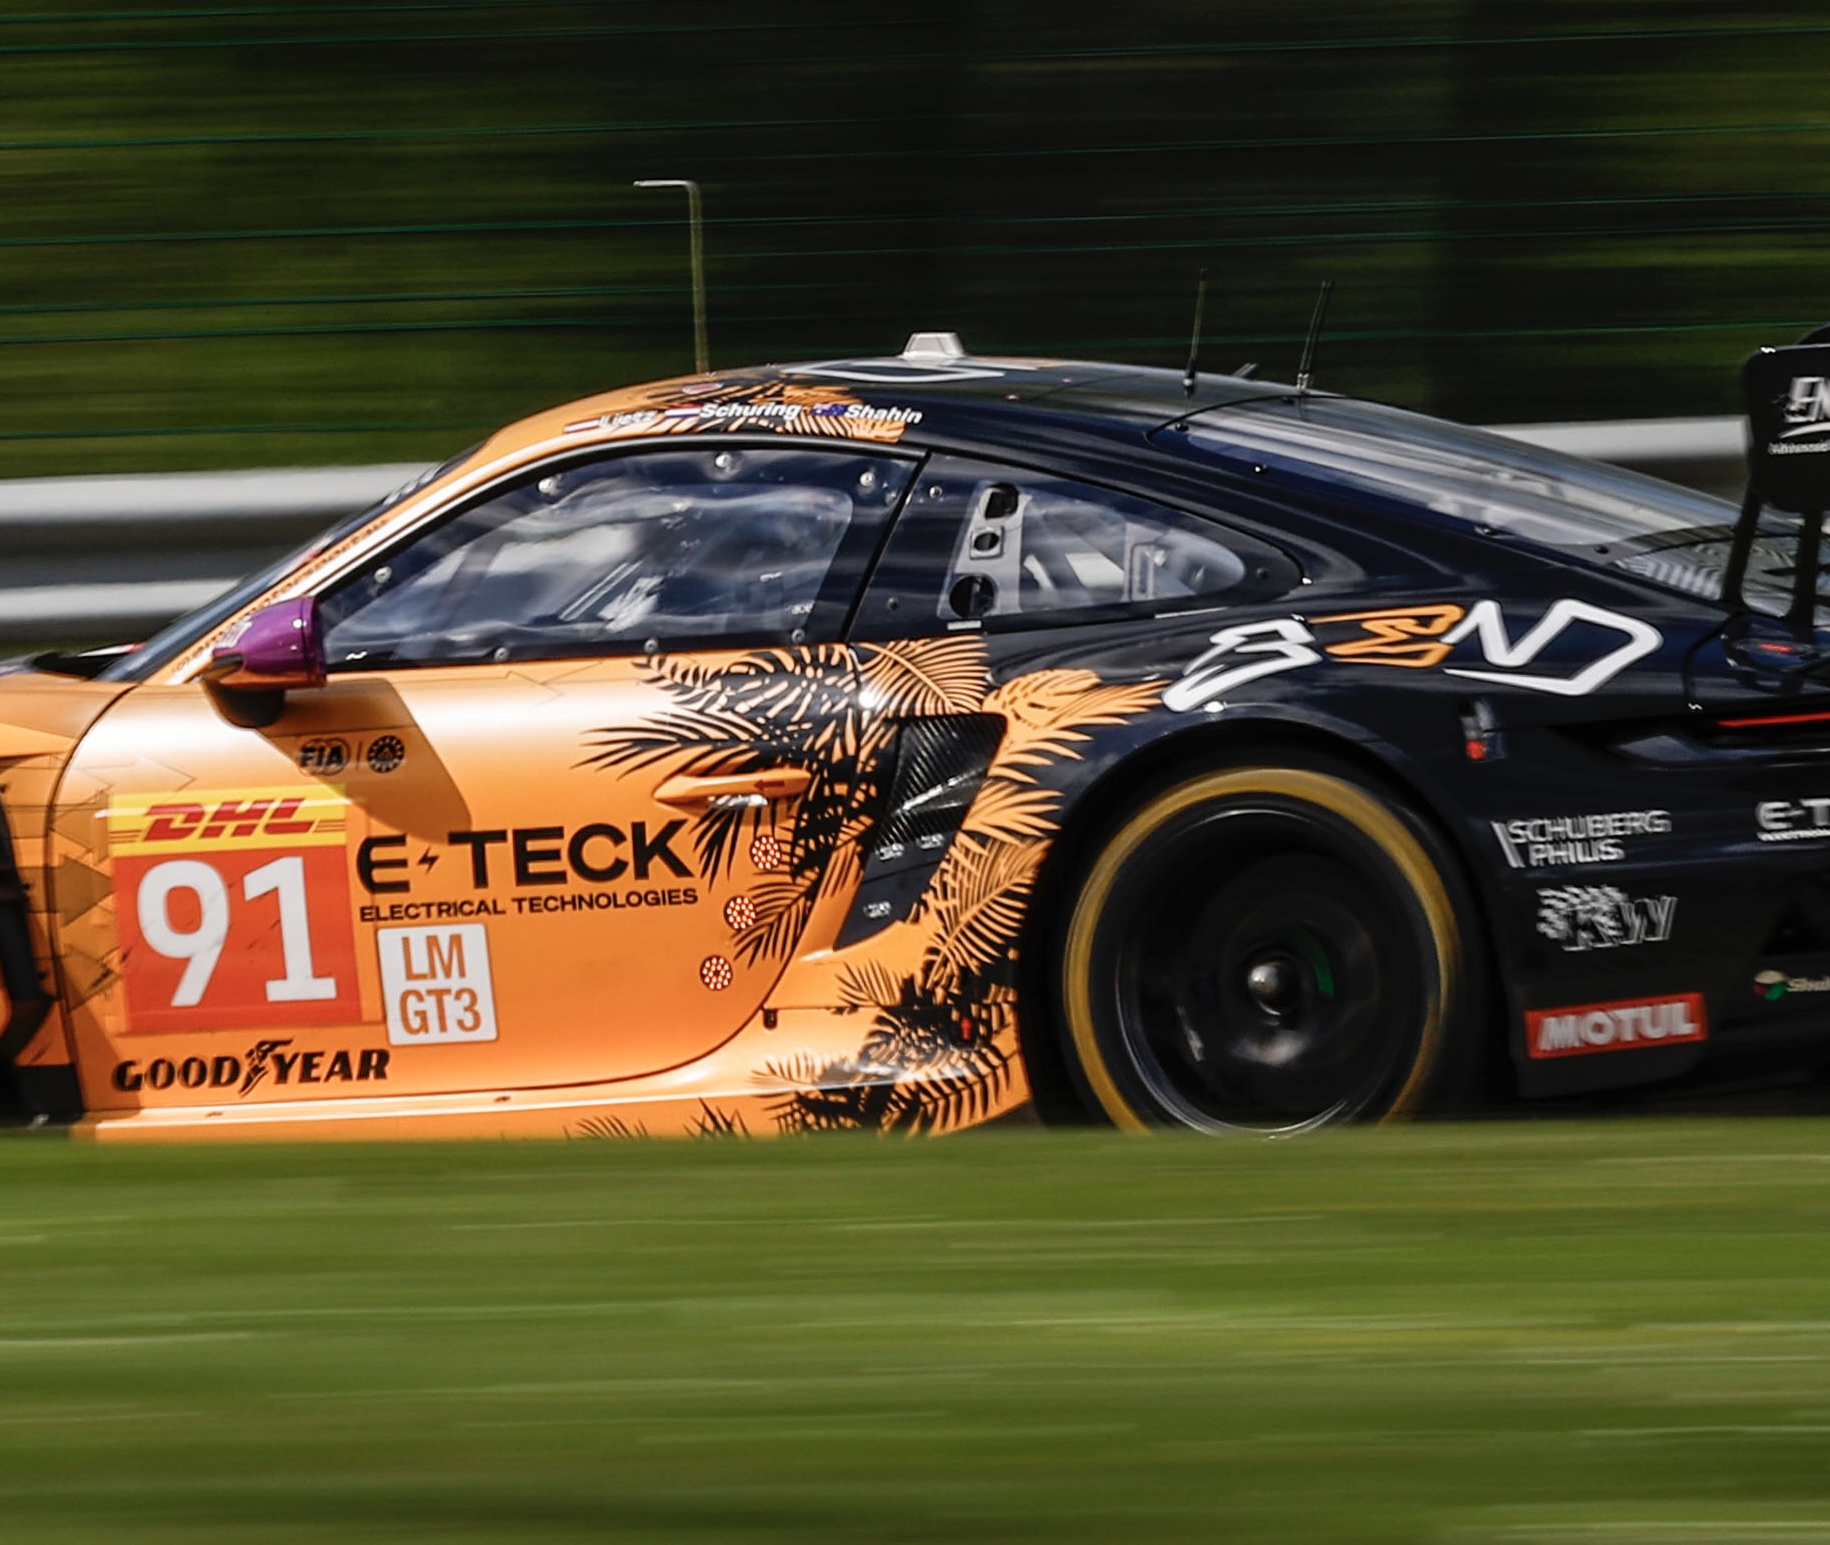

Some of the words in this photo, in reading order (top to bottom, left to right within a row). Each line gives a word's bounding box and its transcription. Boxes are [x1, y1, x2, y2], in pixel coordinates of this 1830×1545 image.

[699, 401, 801, 420] Schuring
[844, 404, 923, 424] Shahin
[299, 745, 345, 768] FIA
[143, 798, 314, 842] DHL
[359, 899, 506, 924] ELECTRICAL
[511, 888, 699, 915] TECHNOLOGIES
[136, 856, 338, 1007] 91
[401, 932, 467, 982] LM
[398, 987, 483, 1036] GT3
[1538, 1001, 1700, 1052] MOTUL
[111, 1040, 391, 1095] GOODYEAR
